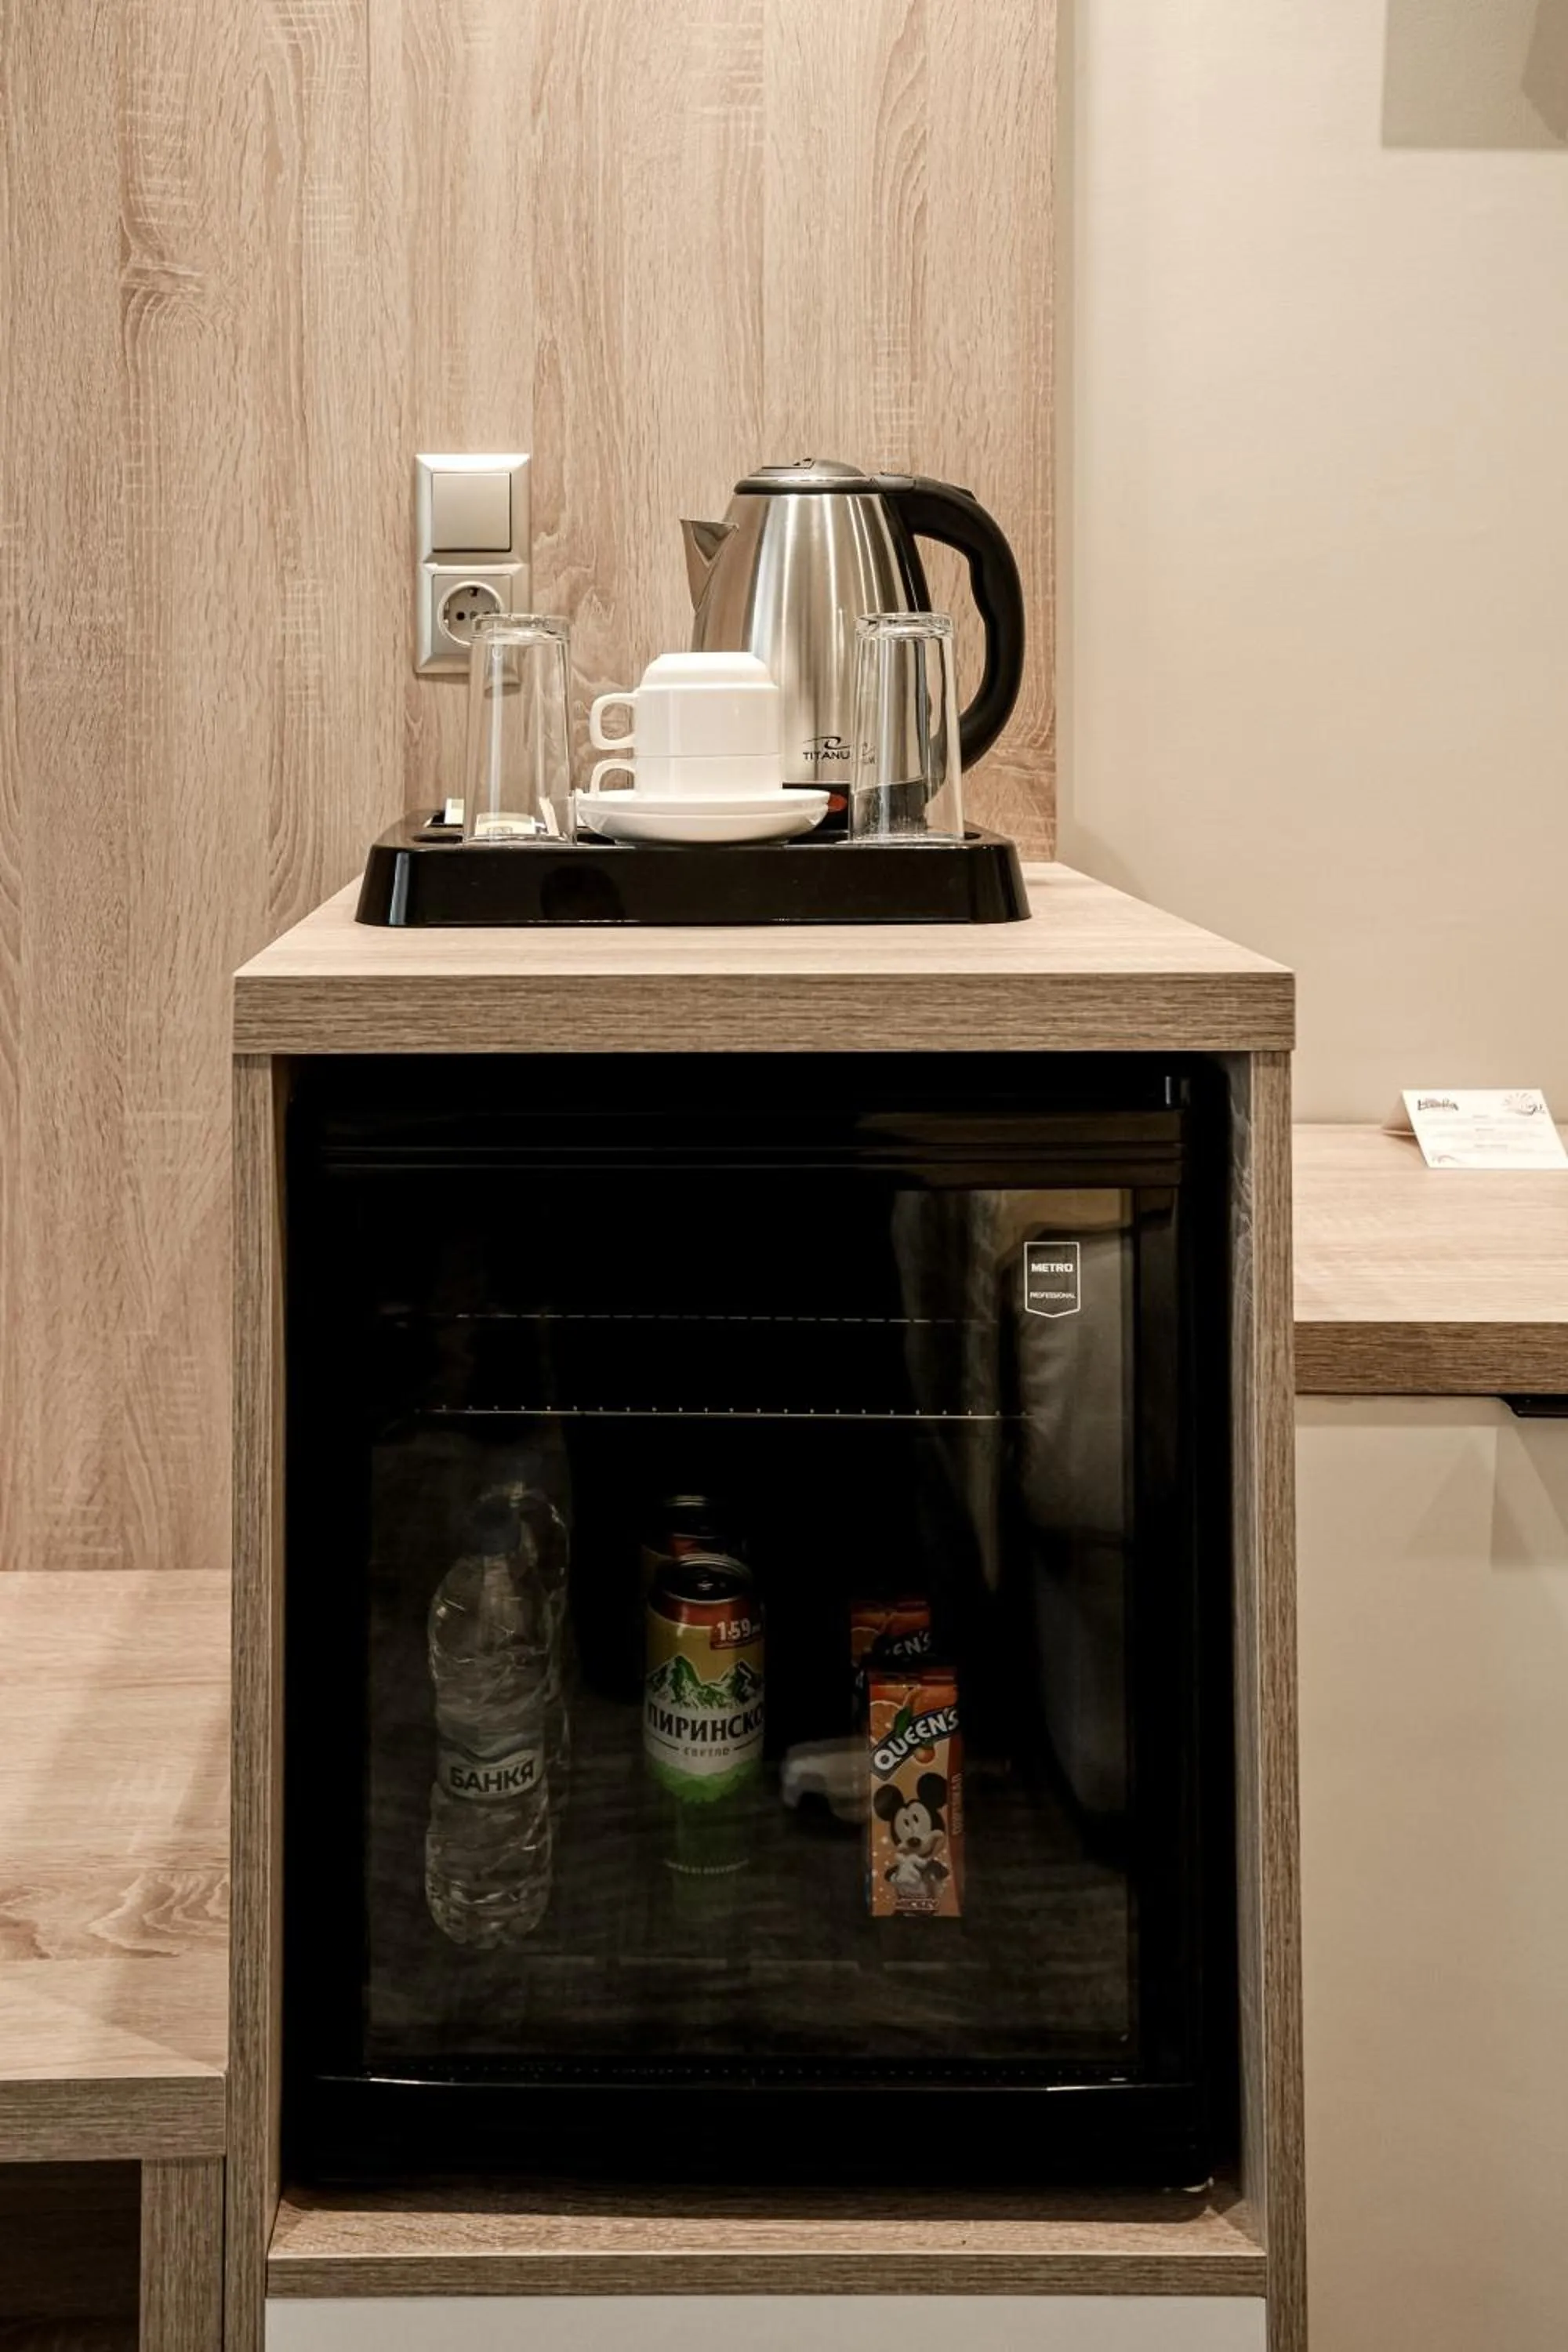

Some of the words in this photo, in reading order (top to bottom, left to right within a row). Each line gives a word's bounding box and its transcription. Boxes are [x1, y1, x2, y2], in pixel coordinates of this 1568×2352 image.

[802, 750, 851, 760] TITANU
[1031, 1263, 1073, 1272] METRO
[874, 1708, 960, 1770] QUEEN'S
[450, 1758, 535, 1792] БАНКЯ
